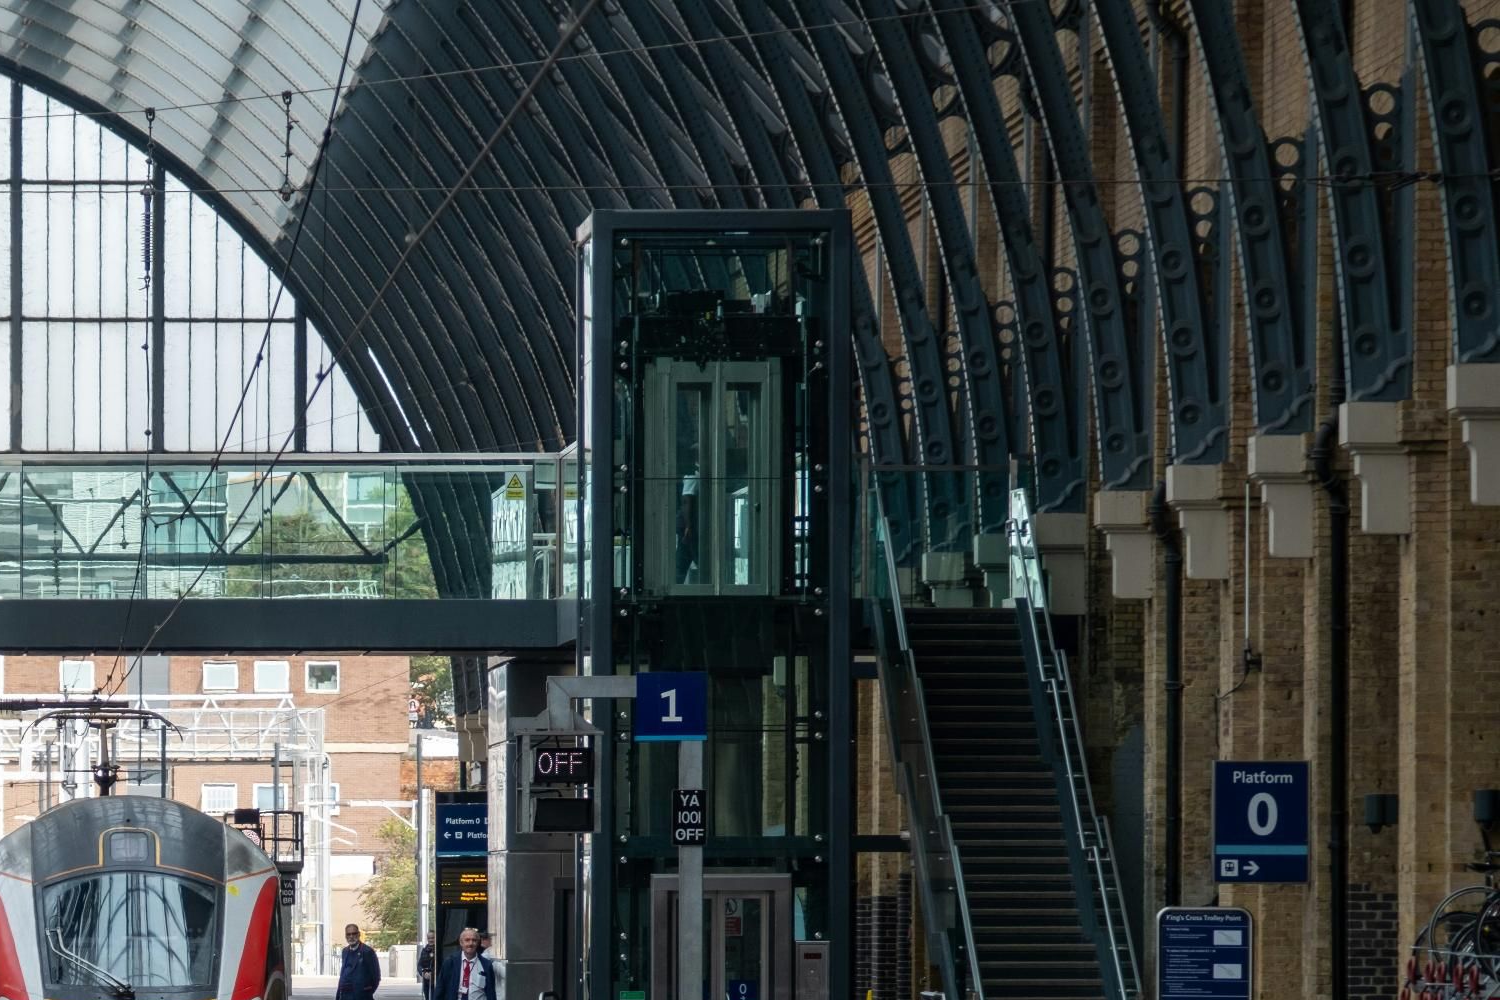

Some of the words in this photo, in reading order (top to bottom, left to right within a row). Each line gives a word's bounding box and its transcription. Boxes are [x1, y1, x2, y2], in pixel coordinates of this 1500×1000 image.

[660, 688, 683, 722] 1
[538, 752, 583, 774] OFF
[1233, 770, 1293, 784] Platform
[680, 794, 700, 807] YA
[678, 811, 701, 824] 1001
[1247, 792, 1278, 836] 0
[445, 817, 475, 825] Platform
[467, 831, 487, 839] Platfo
[675, 828, 705, 841] OFF
[739, 983, 747, 995] 0
